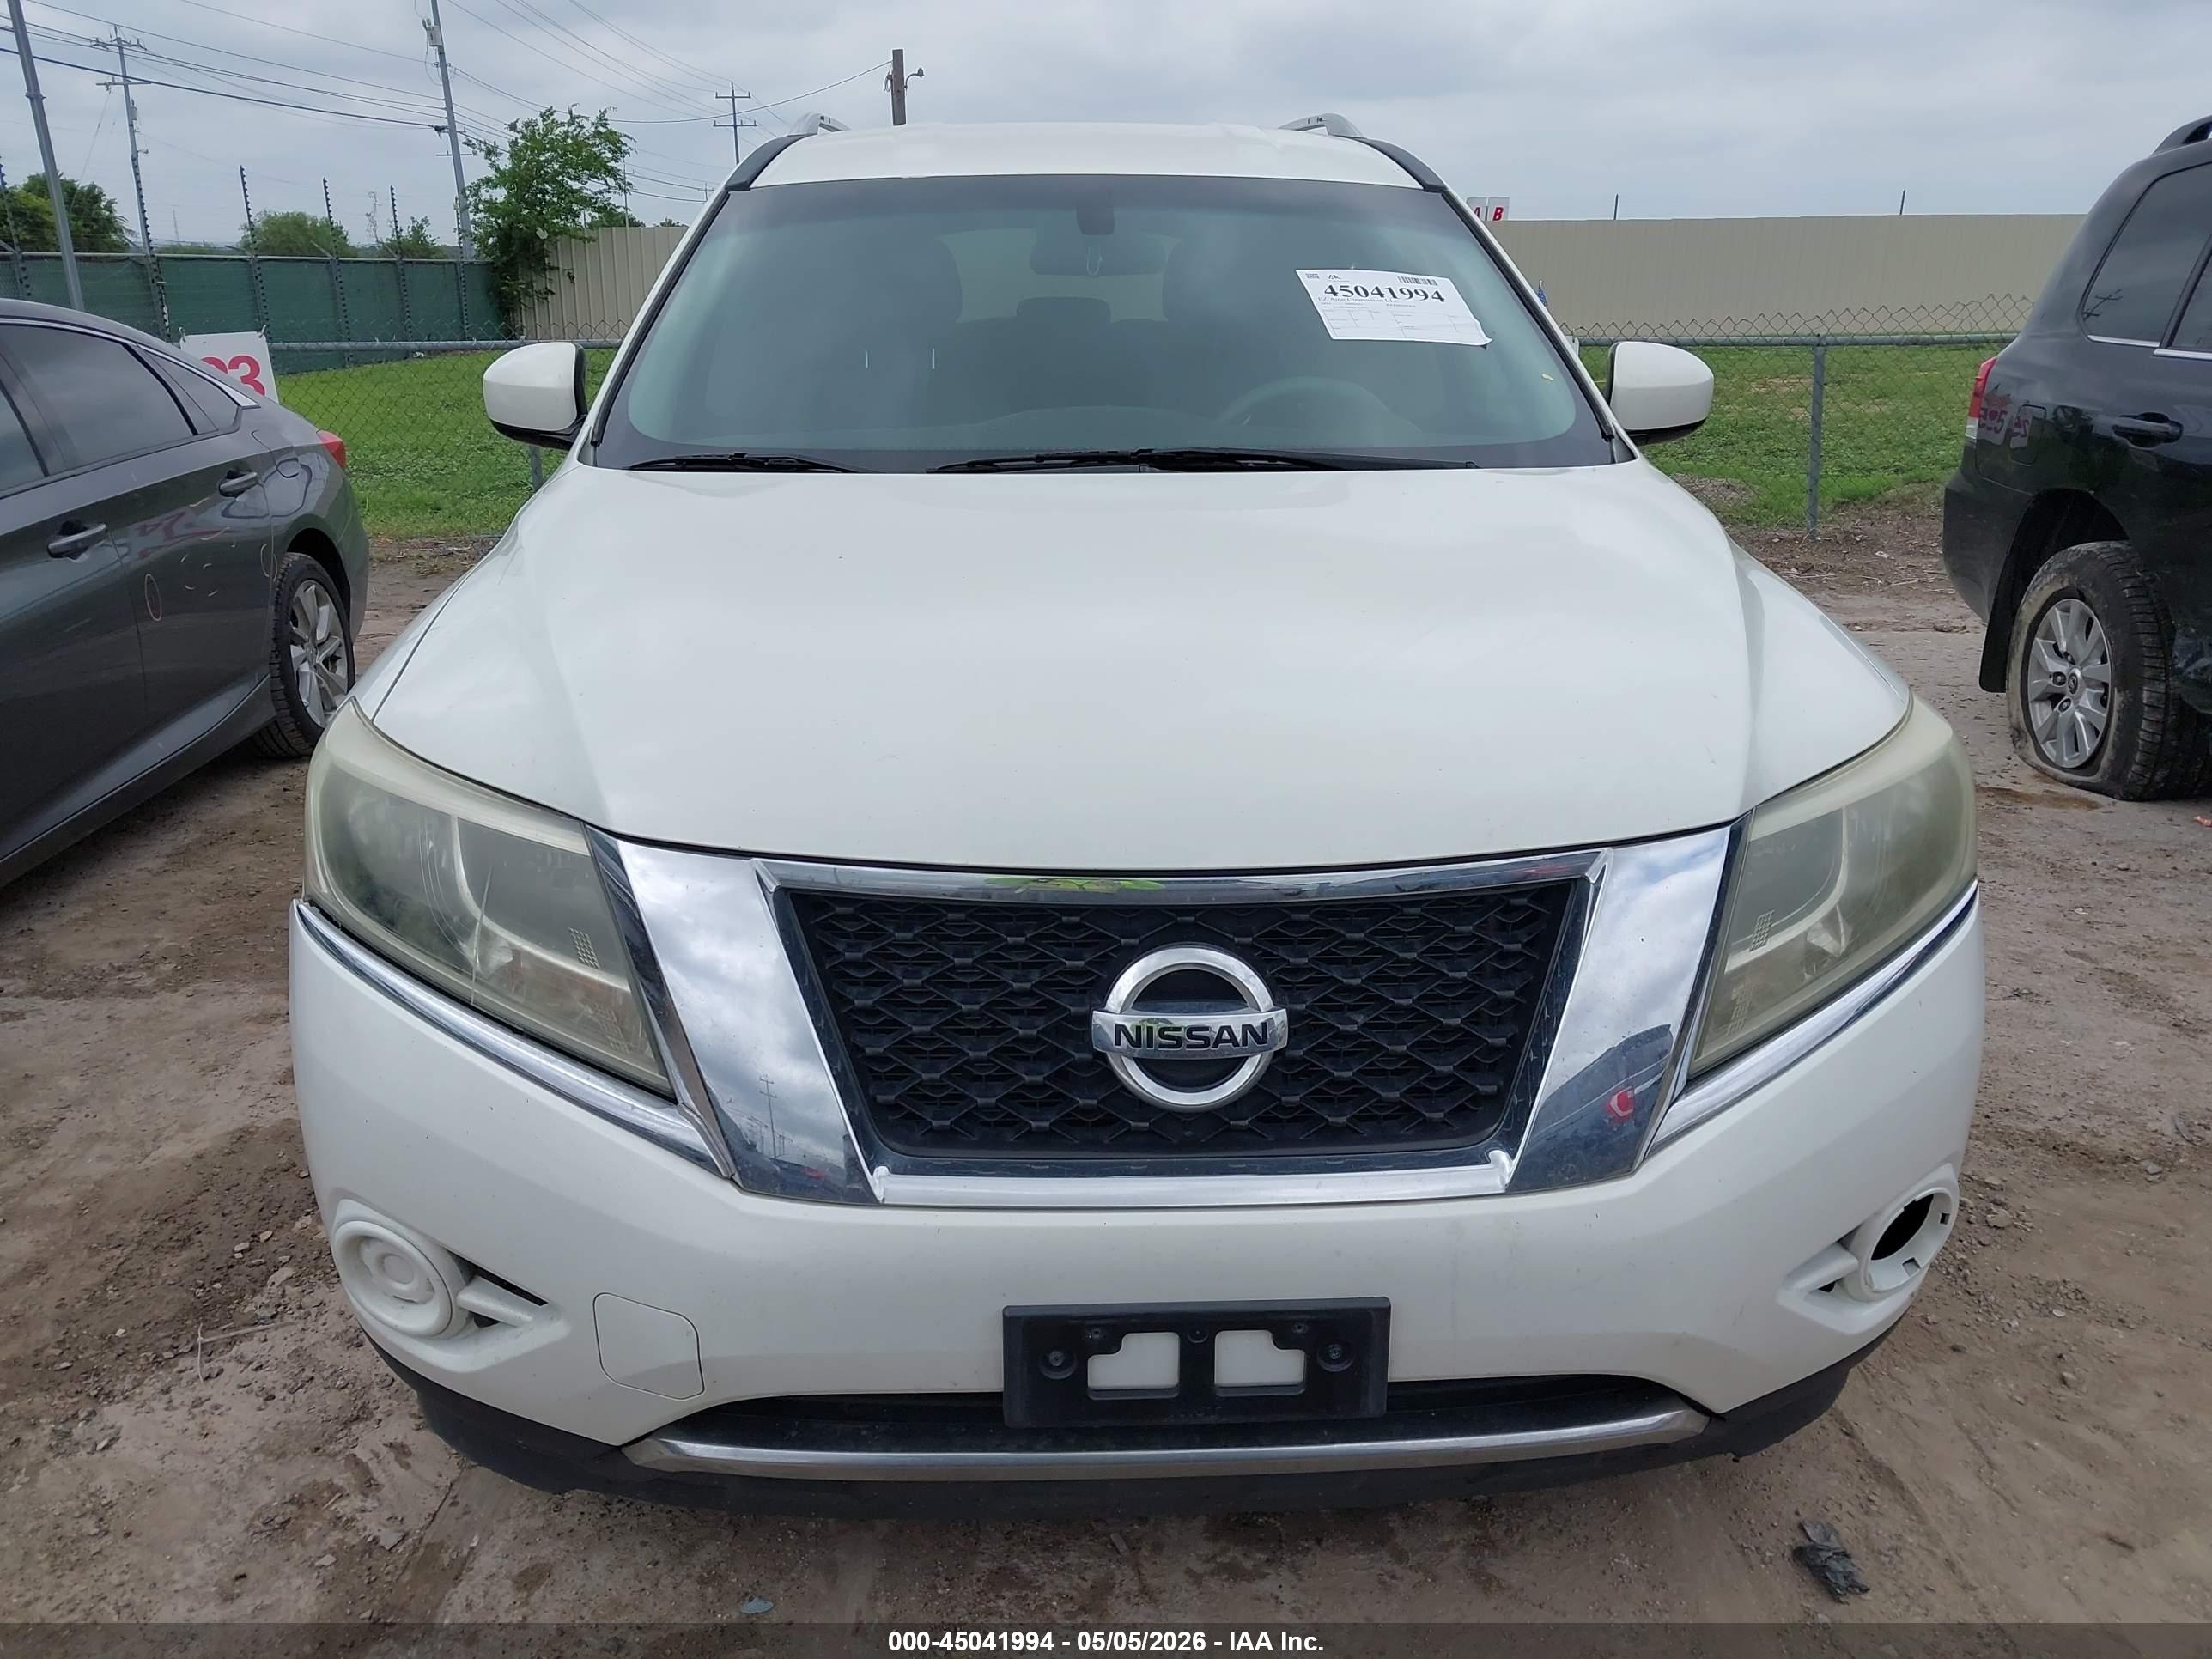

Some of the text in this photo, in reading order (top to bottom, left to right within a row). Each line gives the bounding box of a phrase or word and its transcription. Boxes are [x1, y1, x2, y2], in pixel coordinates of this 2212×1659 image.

[1492, 206, 1504, 221] B
[1323, 284, 1445, 302] 45041994
[1113, 1021, 1268, 1049] NISSAN
